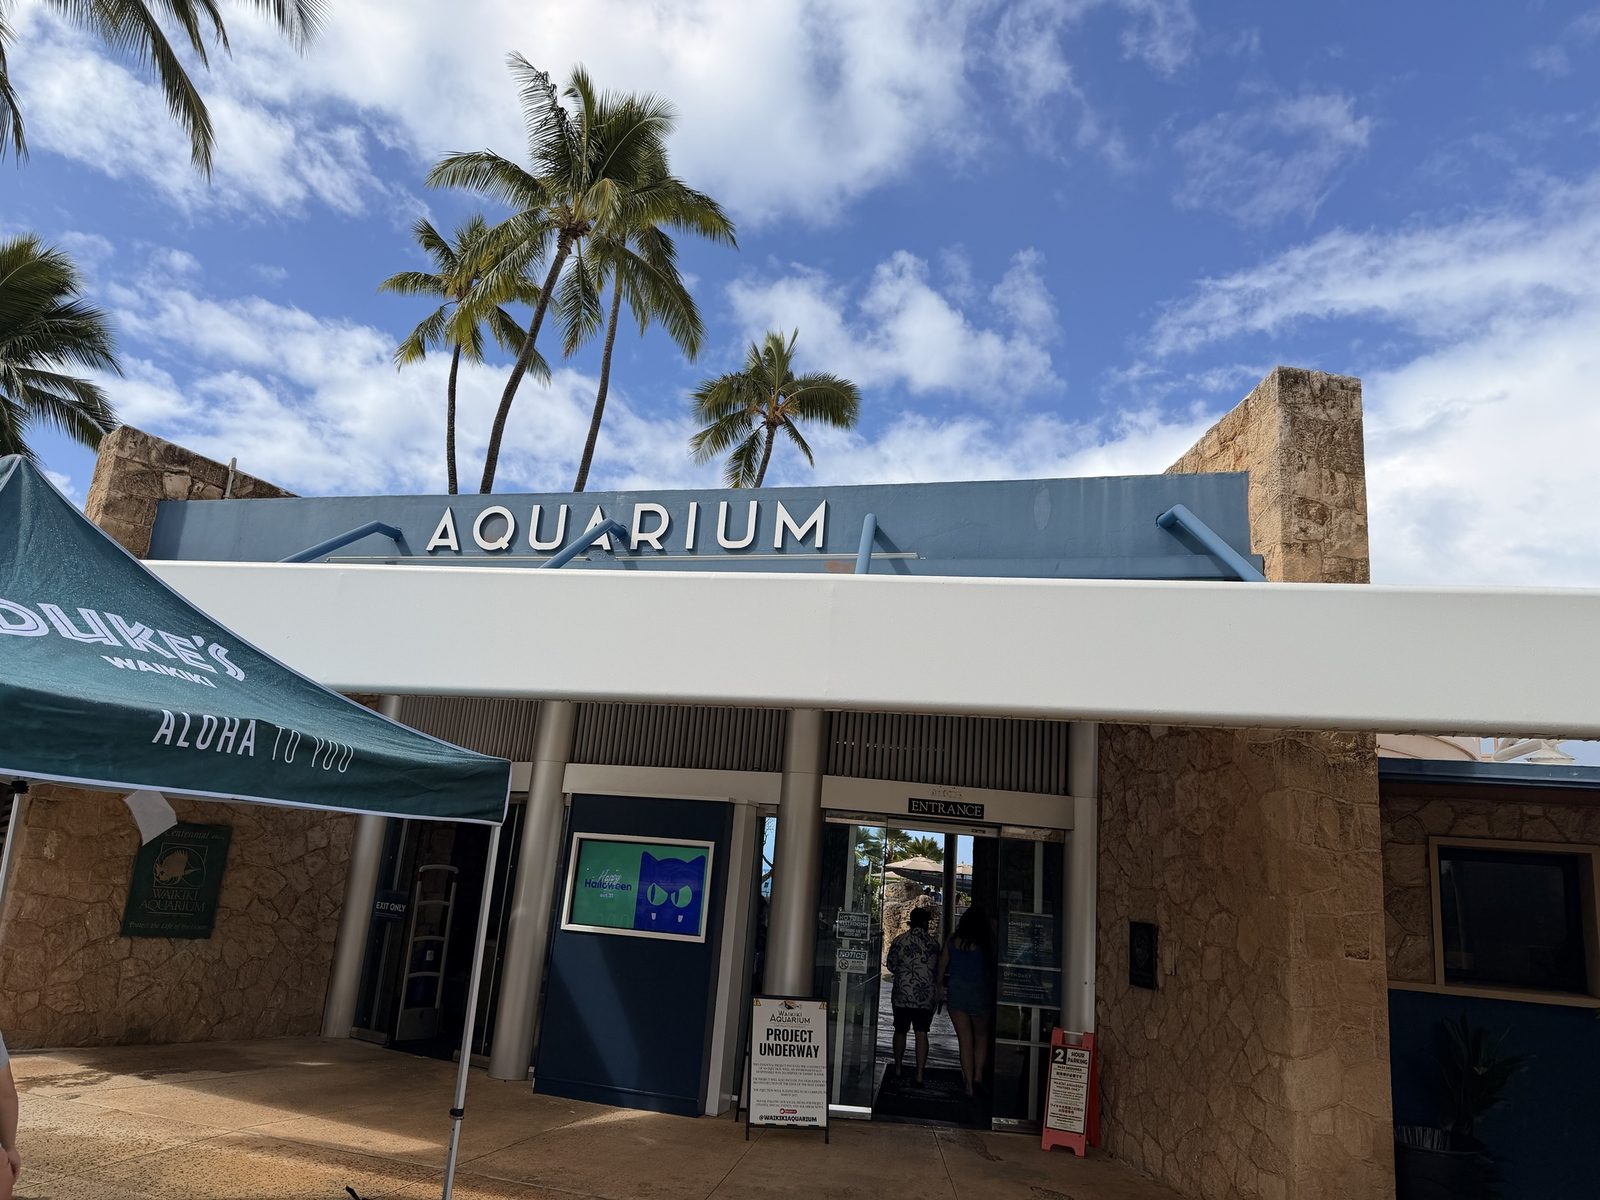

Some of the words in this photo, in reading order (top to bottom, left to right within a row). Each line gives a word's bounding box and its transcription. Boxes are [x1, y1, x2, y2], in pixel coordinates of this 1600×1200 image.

[426, 500, 827, 551] AQUARIUM
[0, 598, 246, 682] DUKE'S
[100, 655, 218, 689] WAIKIKI
[151, 709, 256, 757] ALOHA
[272, 725, 301, 764] TO
[311, 735, 354, 774] YOU
[911, 800, 982, 817] ENTRANCE
[585, 879, 632, 891] Halloween
[152, 888, 199, 902] WAIKIKI
[138, 899, 207, 913] AQUARIUM
[376, 901, 390, 910] EXIT
[389, 903, 407, 912] ONLY
[839, 951, 866, 960] NOTICE
[769, 1014, 811, 1024] AQUARIUM
[766, 1028, 813, 1043] PROJECT
[759, 1043, 820, 1058] UNDERWAY
[1054, 1048, 1065, 1062] 2
[1067, 1057, 1088, 1065] PARKING
[758, 1114, 818, 1123] @WAIKIKIAQUARIUM
